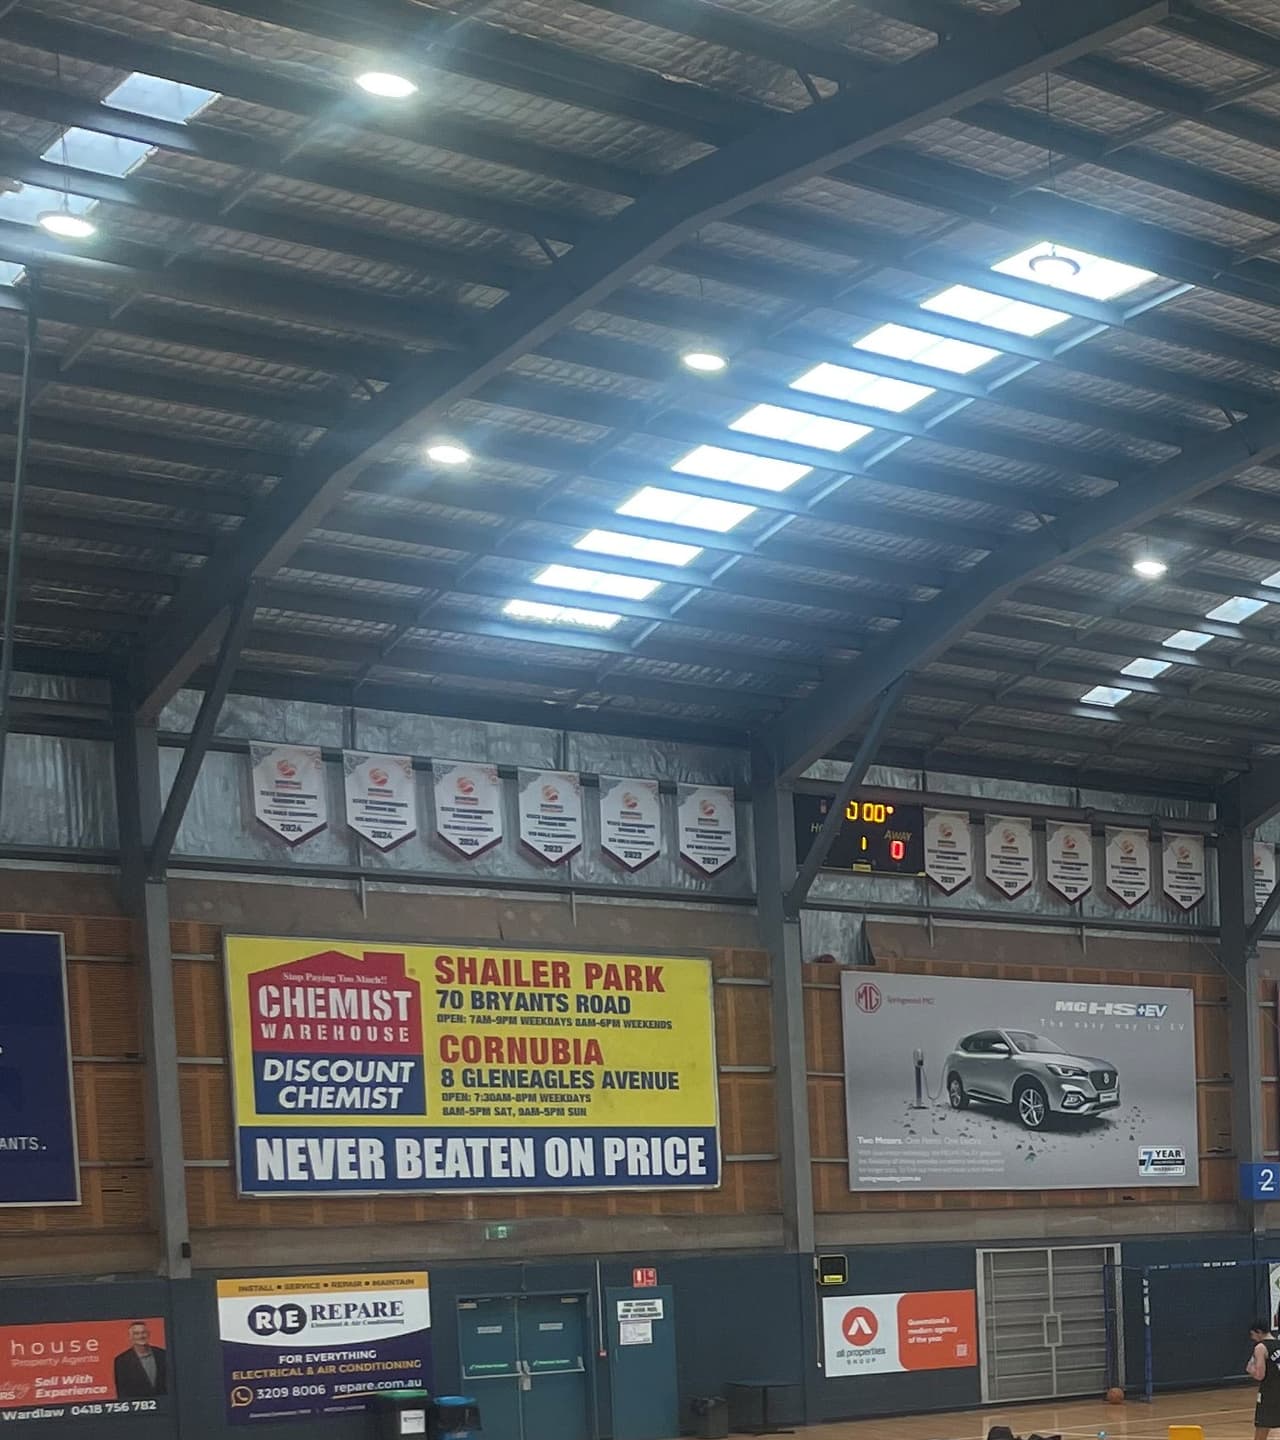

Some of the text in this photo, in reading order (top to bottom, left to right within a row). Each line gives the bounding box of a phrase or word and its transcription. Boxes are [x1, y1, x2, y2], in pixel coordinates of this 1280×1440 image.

[280, 823, 303, 833] 2024
[884, 830, 912, 841] AWAY
[890, 840, 904, 860] 0
[306, 973, 336, 984] Paying
[435, 955, 666, 992] SHAILER PARK
[258, 985, 412, 1022] CHEMIST
[436, 989, 631, 1014] 70 BRYANTS ROAD
[437, 1014, 467, 1024] OPEN:
[469, 1014, 517, 1025] 7AM-9PM
[520, 1016, 572, 1027] WEEKDAYS
[623, 1019, 672, 1030] WEEKENDS
[261, 1023, 409, 1043] WAREHOUSE
[439, 1035, 604, 1066] CORNUBIA
[263, 1059, 415, 1083] DISCOUNT
[441, 1069, 679, 1090] 8 GLENEAGLES AVENUE
[278, 1086, 403, 1109] CHEMIST
[442, 1092, 471, 1102] OPEN:
[540, 1093, 592, 1103] WEEKDAYS
[494, 1107, 516, 1118] SAT,
[567, 1107, 587, 1117] SUN
[255, 1136, 707, 1181] NEVER BEATEN ON PRICE
[1142, 1149, 1182, 1172] 7 YEAR
[1261, 1168, 1274, 1191] 2
[238, 1278, 415, 1293] INSTALL SERVICE REPAIR MAINTAIN
[311, 1300, 404, 1321] REPARE
[11, 1338, 99, 1356] house
[836, 1347, 886, 1358] all properties
[12, 1355, 100, 1368] Property Agents
[279, 1350, 377, 1365] FOR EVERYTHING
[232, 1359, 422, 1381] ELECTRICAL & AIR CONDITIONING
[35, 1374, 93, 1387] Sell With
[256, 1378, 423, 1399] 3209 8006 repare.com.au
[35, 1385, 108, 1399] Experience
[3, 1400, 157, 1421] Wardlaw 0418 756 782
